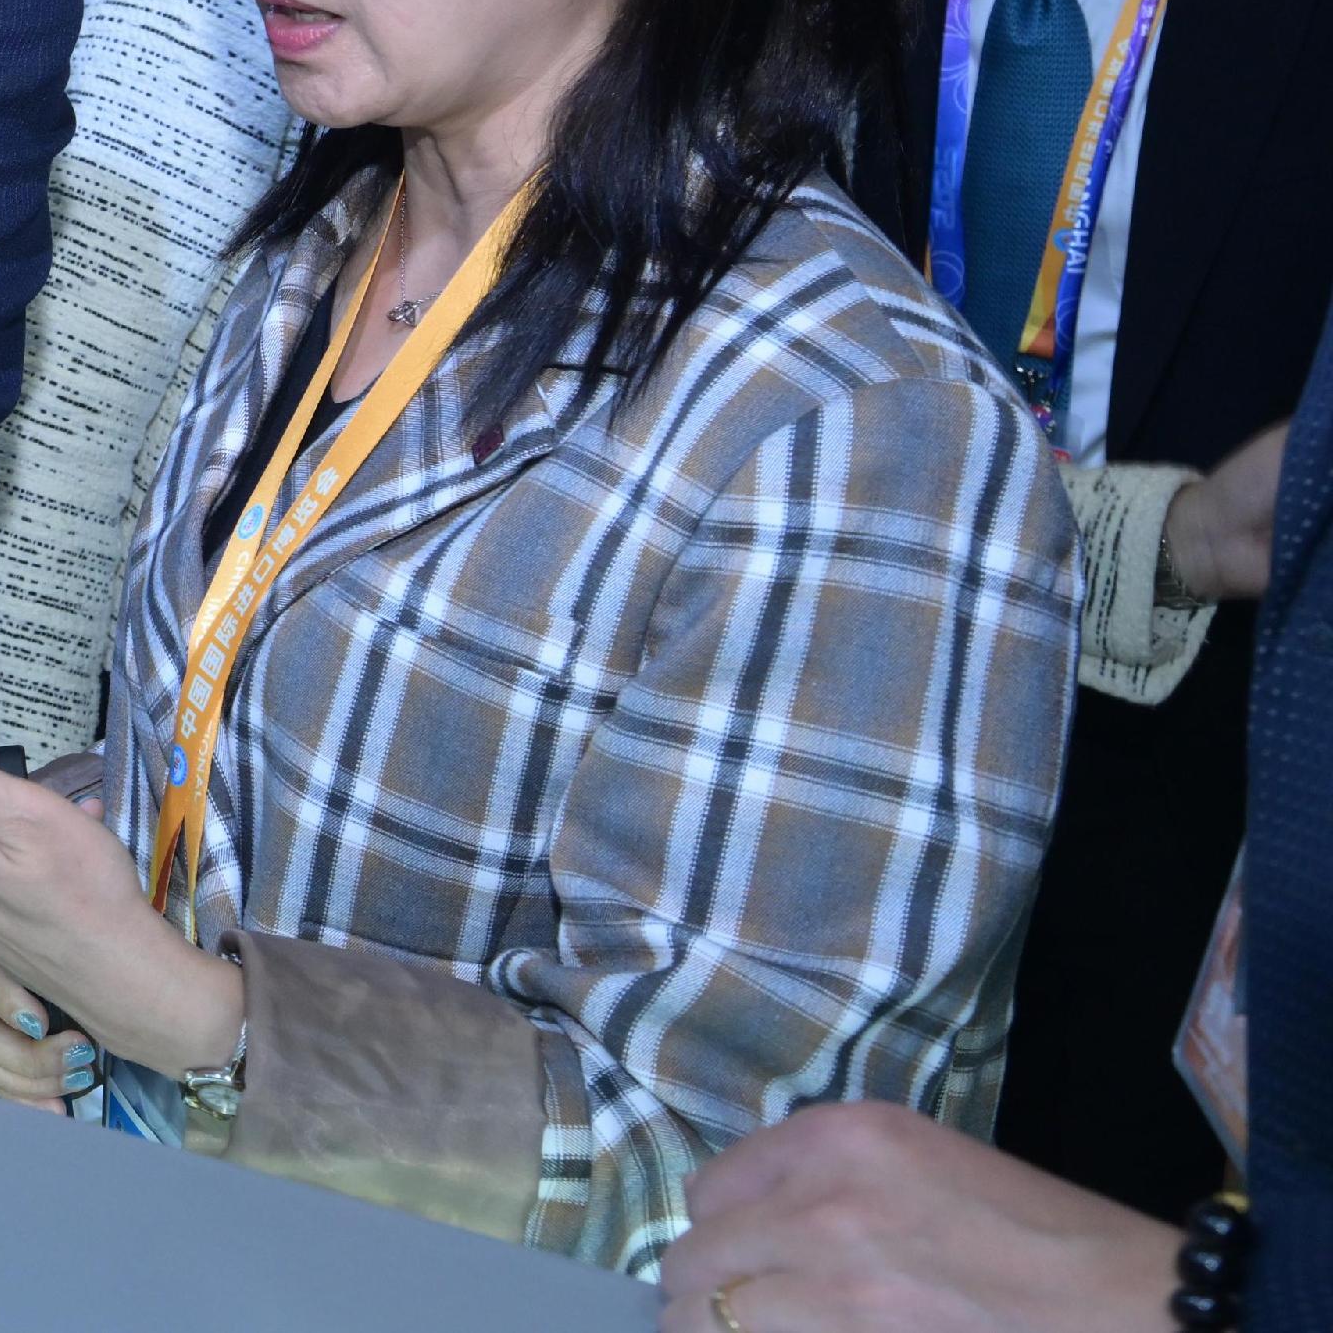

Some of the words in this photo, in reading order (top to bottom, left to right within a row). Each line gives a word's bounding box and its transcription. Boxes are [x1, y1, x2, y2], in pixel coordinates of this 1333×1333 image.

[181, 466, 340, 741] 中国国际进口博览会
